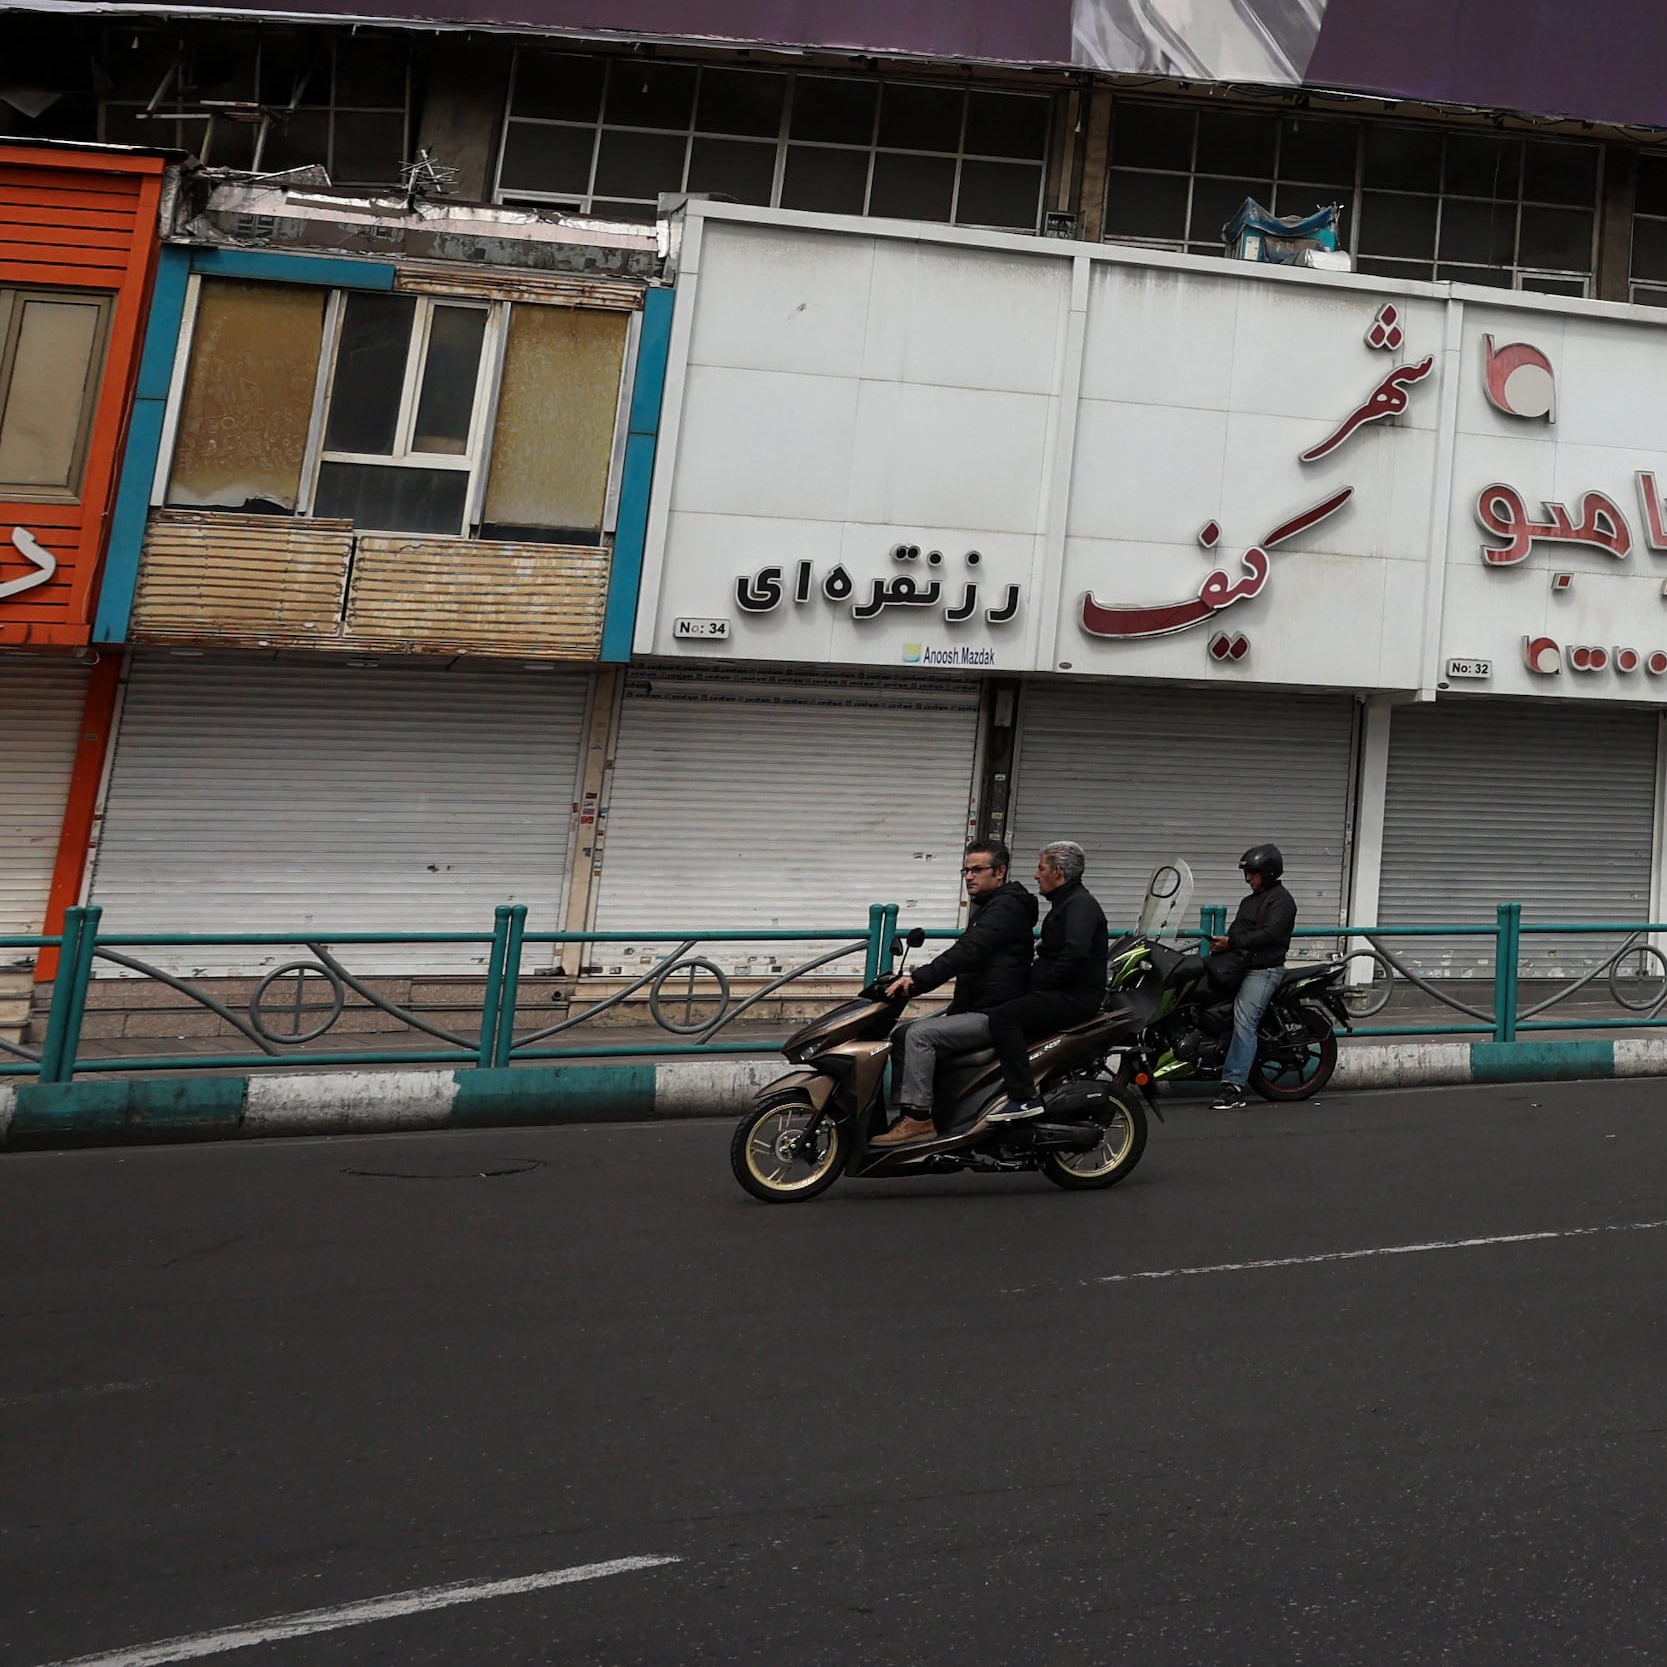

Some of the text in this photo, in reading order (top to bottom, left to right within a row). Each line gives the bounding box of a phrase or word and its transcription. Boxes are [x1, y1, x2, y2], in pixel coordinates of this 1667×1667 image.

[1080, 303, 1436, 662] شهر کیف
[709, 622, 726, 635] 34
[1475, 663, 1489, 675] 32
